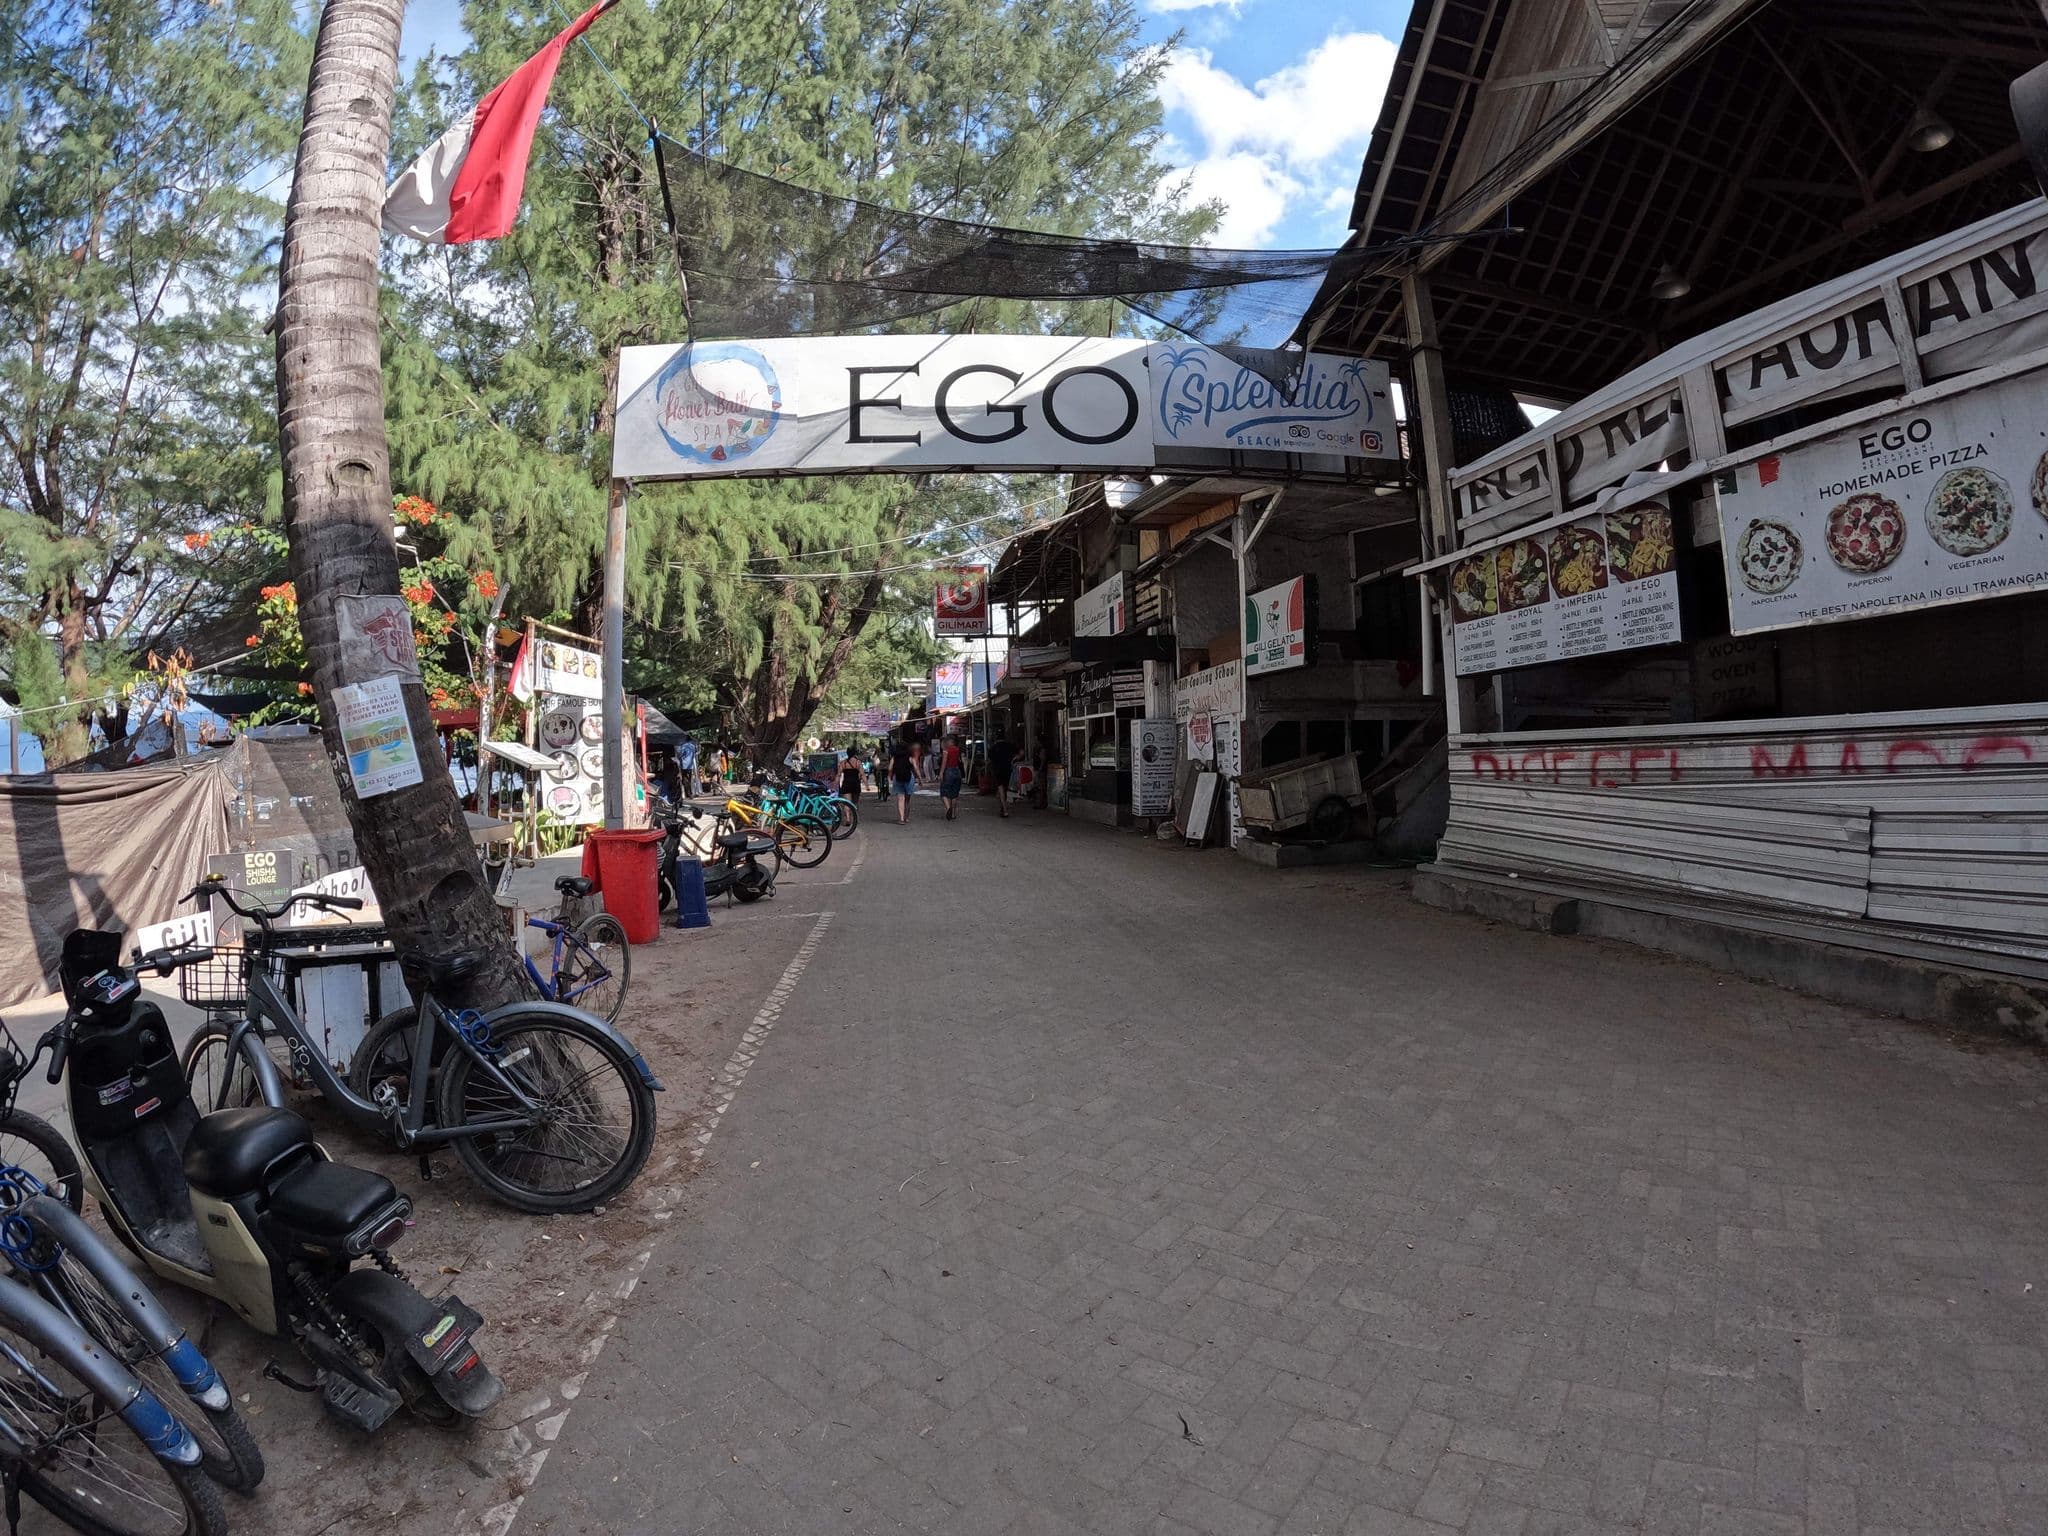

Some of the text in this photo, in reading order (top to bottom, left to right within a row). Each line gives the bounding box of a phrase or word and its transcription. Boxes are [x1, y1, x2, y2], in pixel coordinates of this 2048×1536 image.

[845, 362, 1140, 447] EGO
[694, 425, 722, 442] SPA
[1237, 435, 1281, 448] BEACH
[1317, 429, 1355, 444] Google
[1858, 418, 1932, 459] EGO
[1819, 443, 1988, 499] HOMEMADE PIZZA
[1948, 555, 2004, 571] VEGETARIAN
[1641, 579, 1660, 590] EGO
[1567, 592, 1608, 607] IMPERIAL
[1751, 592, 1798, 606] NAPOLETANA
[1798, 609, 1819, 619] THE
[1821, 604, 1847, 618] BEST
[1851, 592, 1926, 611] NAPOLETANA
[1930, 588, 1942, 599] IN
[1946, 585, 1969, 597] GILI
[1518, 606, 1542, 618] ROYAL
[938, 620, 985, 631] GILIMART
[1467, 618, 1496, 630] CLASSIC
[1254, 634, 1295, 652] GILI GELATO
[1708, 640, 1757, 657] WOOD
[1190, 672, 1213, 688] Cooking
[1215, 661, 1236, 680] School
[1712, 662, 1755, 680] OVEN
[558, 698, 587, 707] FAMOUS
[244, 852, 276, 868] EGO
[246, 867, 277, 878] SHISHA
[246, 876, 277, 886] LOUNGE
[288, 1037, 310, 1065] ofo
